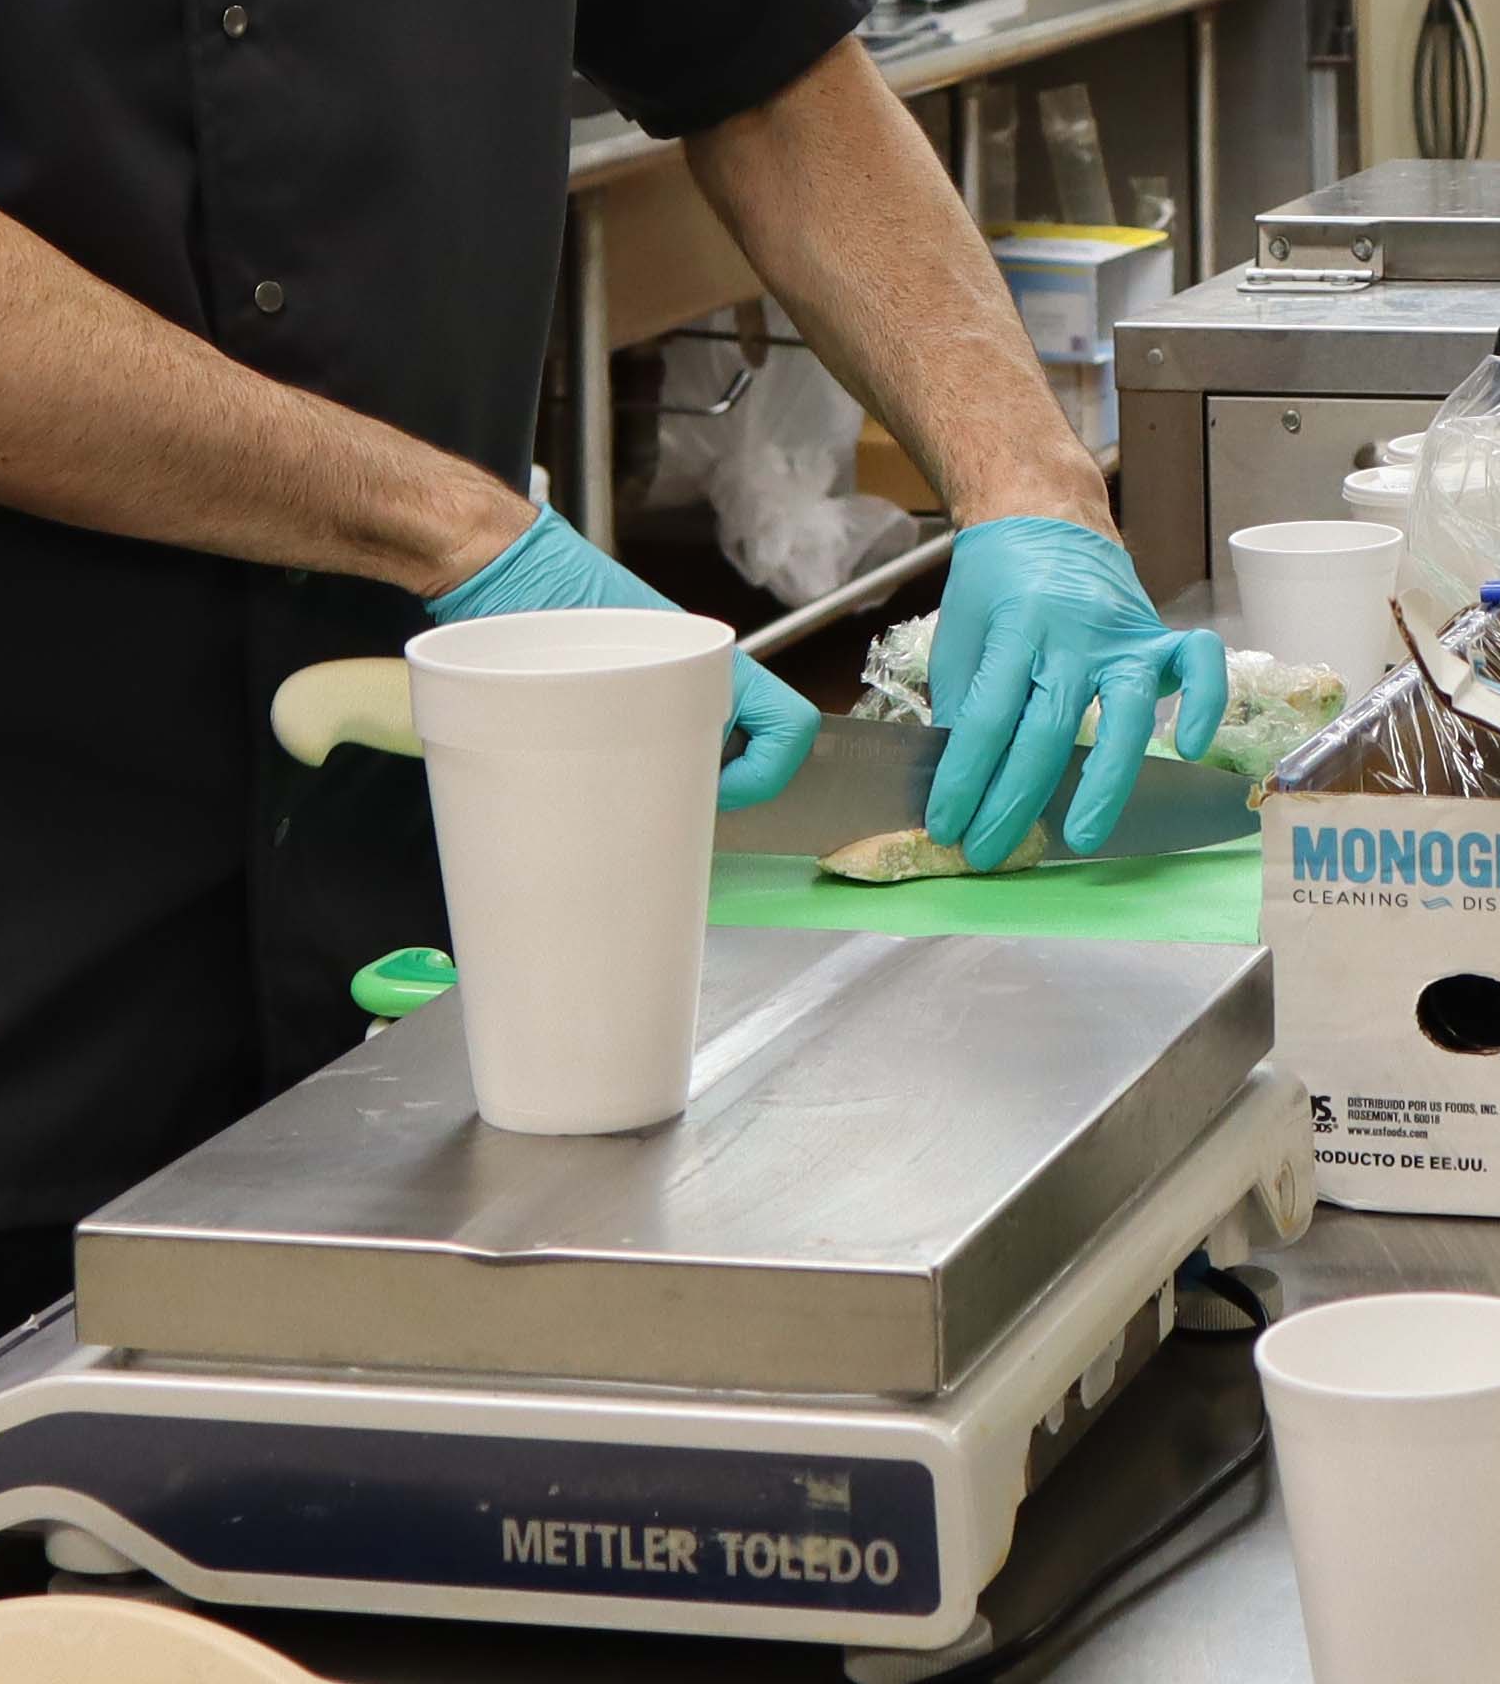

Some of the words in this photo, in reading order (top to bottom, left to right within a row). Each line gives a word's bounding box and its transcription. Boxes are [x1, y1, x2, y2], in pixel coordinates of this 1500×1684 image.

[1293, 889, 1409, 908] CLEANING
[1348, 1097, 1405, 1110] DISTRIBUIDO
[1408, 1100, 1426, 1111] POR
[1429, 1101, 1442, 1112] US
[1445, 1102, 1478, 1115] FOODS,
[1481, 1104, 1499, 1115] INC.
[1348, 1110, 1401, 1124] ROSEMONT,
[1404, 1113, 1411, 1123] IL
[1414, 1113, 1440, 1124] 60018
[1347, 1125, 1428, 1139] www.usfoods.com
[1314, 1149, 1395, 1168] RODUCTO
[1400, 1155, 1425, 1169] DE
[1429, 1156, 1487, 1173] EE.UU.
[502, 1518, 698, 1575] METTLER
[717, 1531, 899, 1586] TOLEDO
